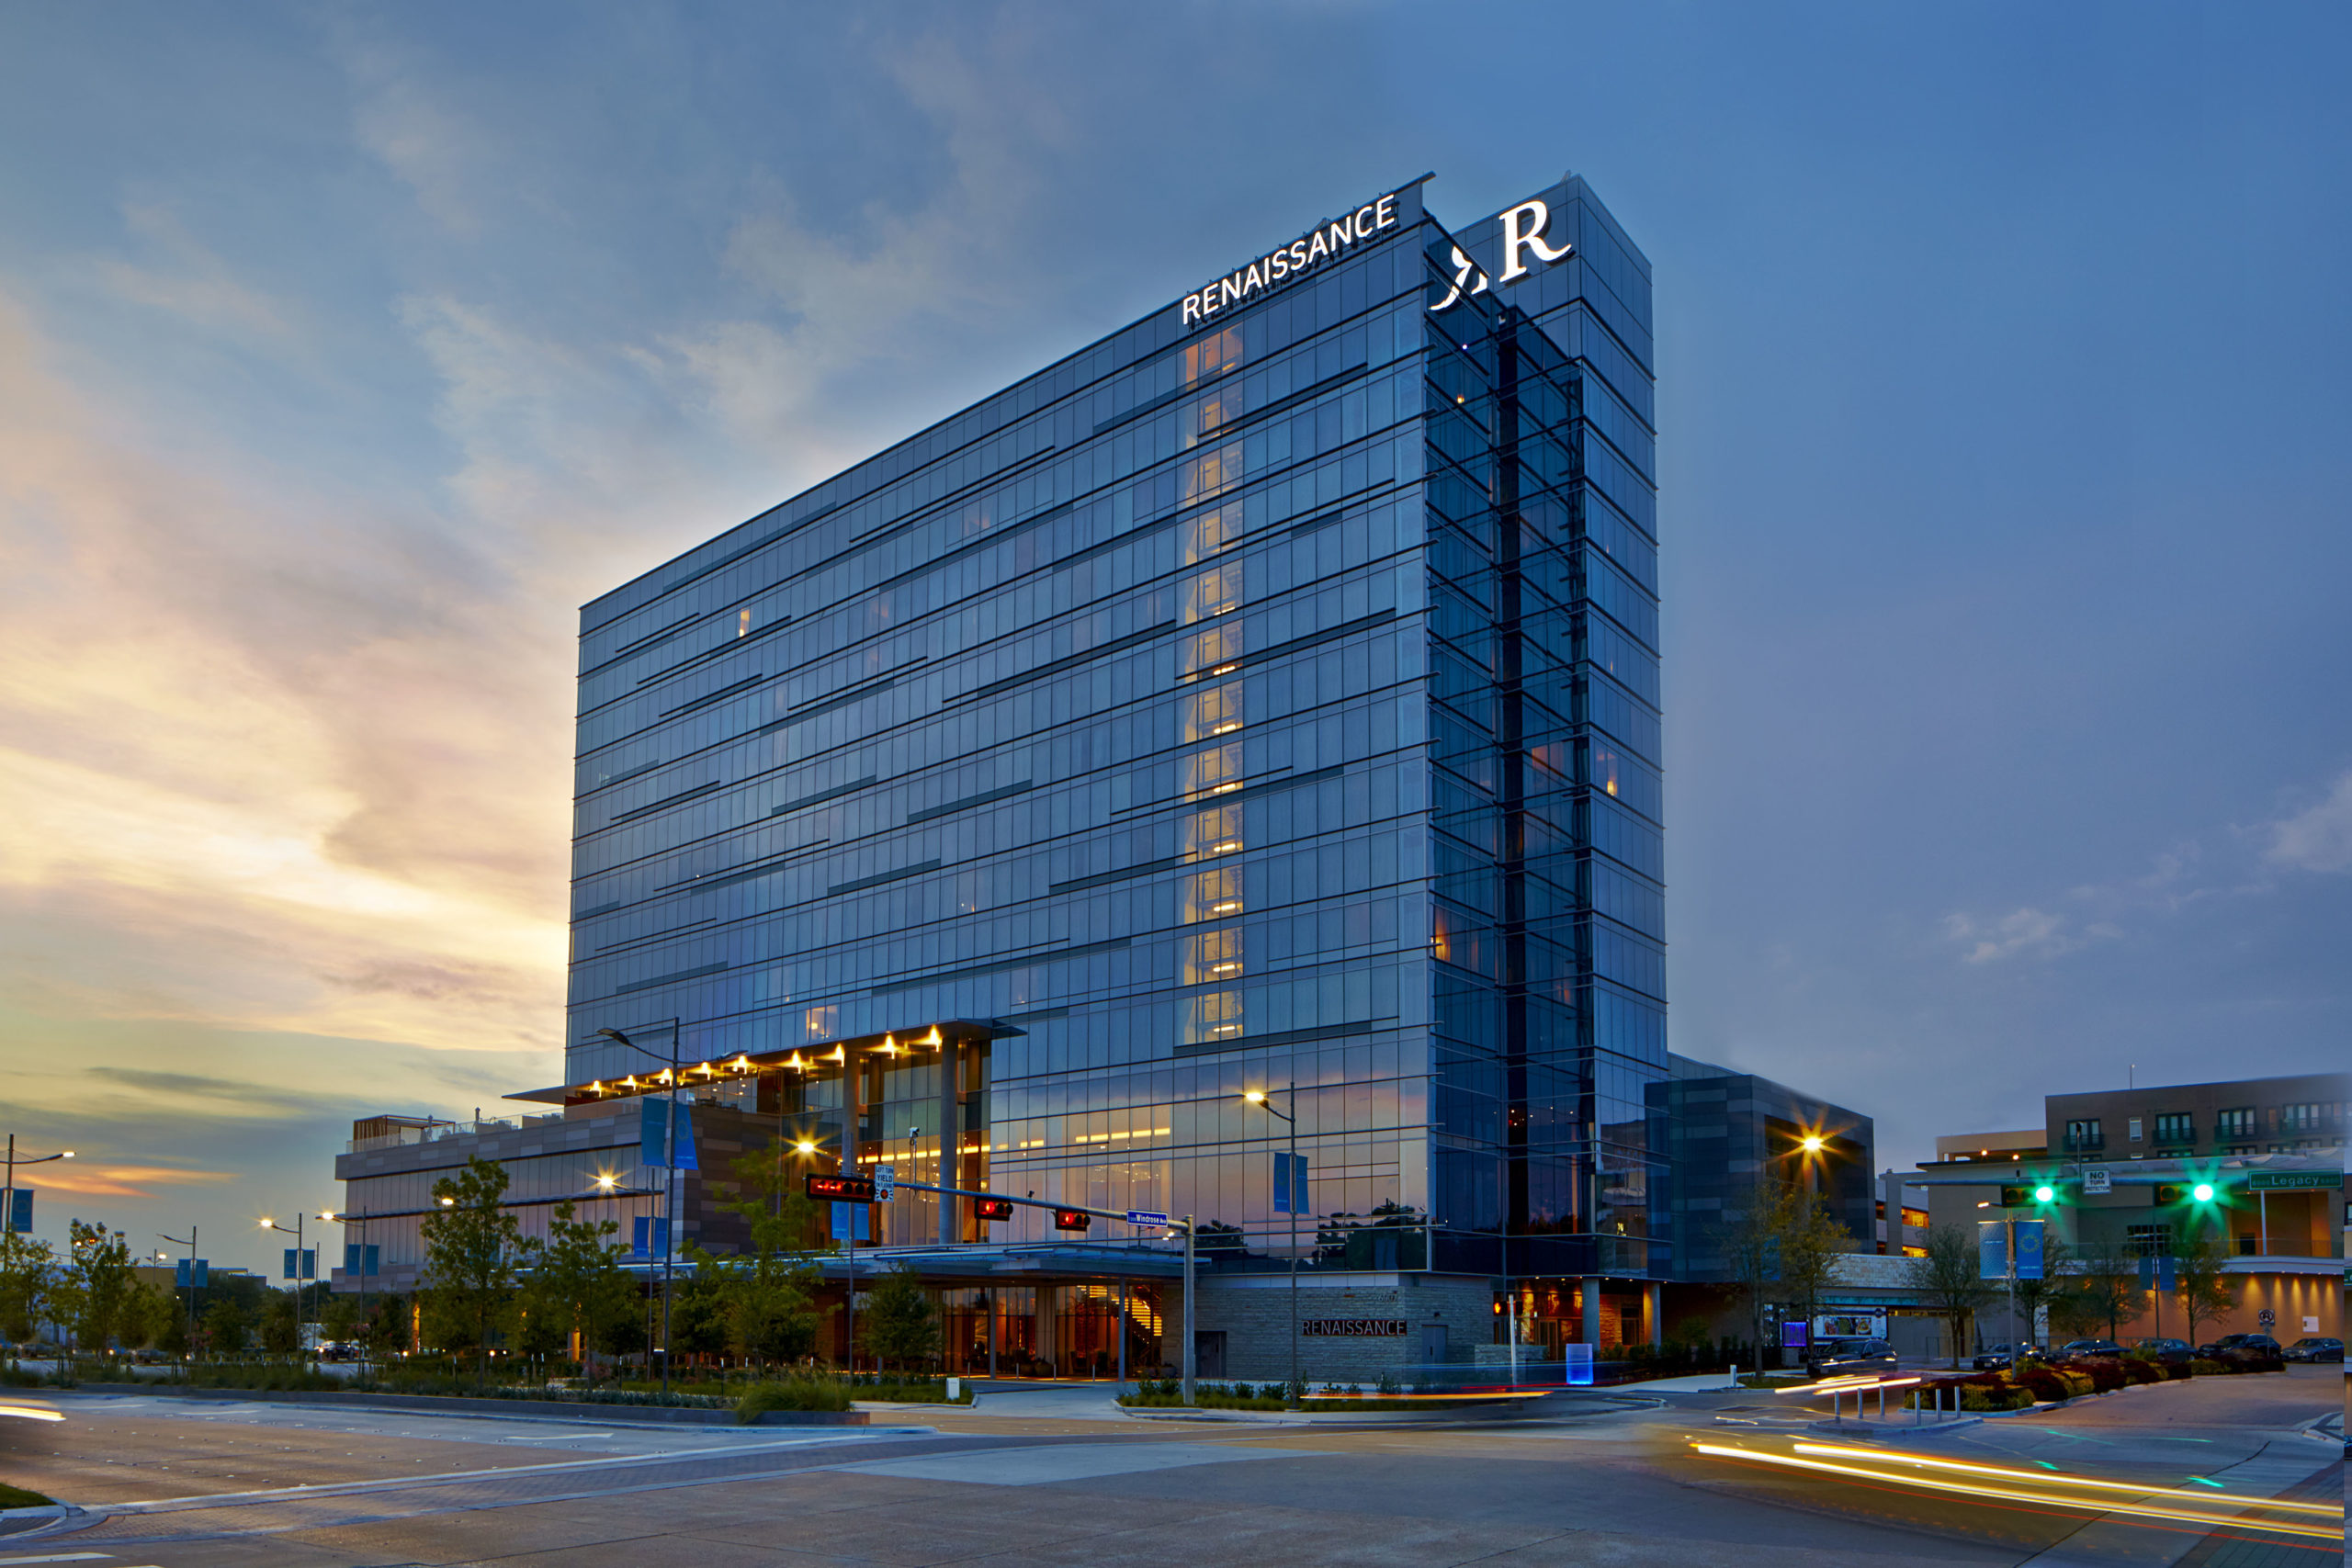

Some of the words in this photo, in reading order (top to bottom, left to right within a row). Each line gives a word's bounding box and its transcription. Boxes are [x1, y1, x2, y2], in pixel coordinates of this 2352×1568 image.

[1498, 199, 1572, 283] R
[1182, 194, 1395, 325] RENAISSANCE
[876, 1174, 892, 1182] YIELD
[2089, 1171, 2105, 1179] NO
[2271, 1176, 2319, 1188] Legacy
[1136, 1213, 1159, 1224] Windrose
[1301, 1320, 1406, 1337] RENAISSANCE
